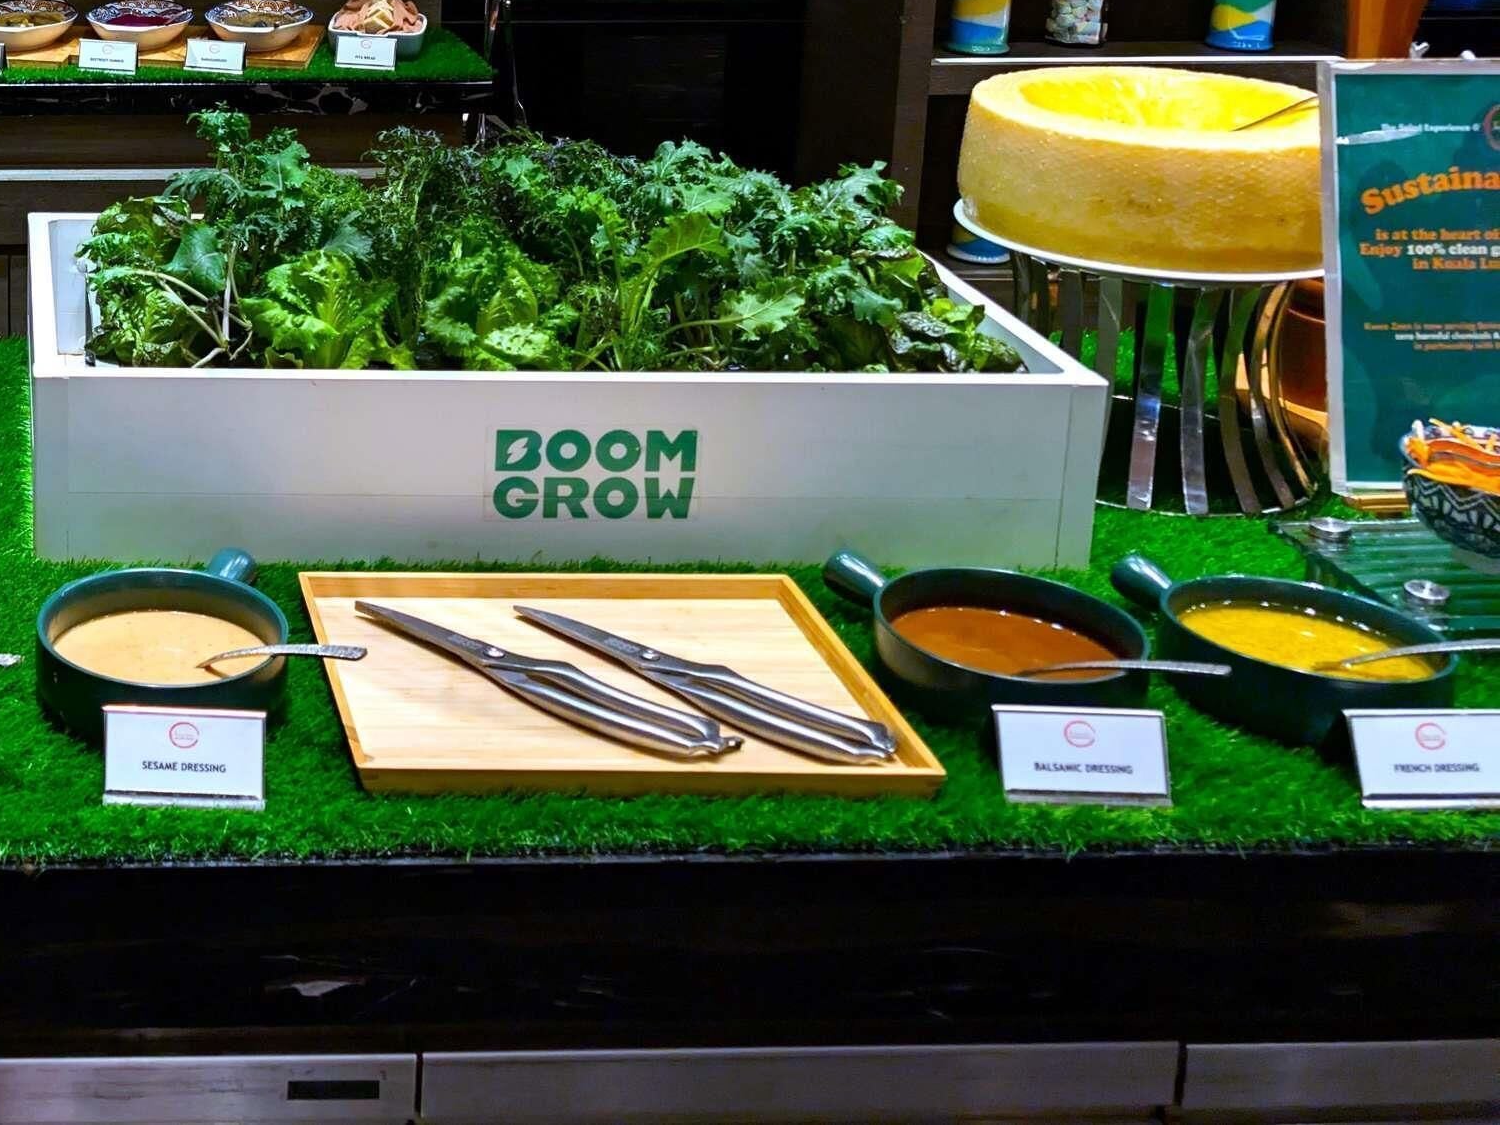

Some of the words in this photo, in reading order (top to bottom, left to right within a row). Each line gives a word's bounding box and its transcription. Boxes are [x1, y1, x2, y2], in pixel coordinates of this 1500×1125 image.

[1424, 123, 1471, 133] Experience
[1360, 165, 1500, 215] Sustaina
[1375, 228, 1389, 241] is
[1392, 229, 1409, 241] at
[1411, 228, 1438, 241] the
[1440, 228, 1481, 241] heart
[1359, 242, 1402, 257] Enjoy
[1407, 243, 1446, 255] 100%
[1448, 243, 1488, 255] clean
[1413, 257, 1430, 269] in
[1432, 257, 1476, 269] Kuala
[494, 428, 698, 473] BOOM
[492, 475, 697, 520] GROW
[142, 760, 178, 772] SESAME
[181, 762, 227, 773] DRESSING
[1034, 762, 1081, 773] BALSAMIC
[1085, 763, 1134, 775] DRESSING
[1394, 763, 1432, 773] FRENCH
[1434, 762, 1481, 773] DRESSING
